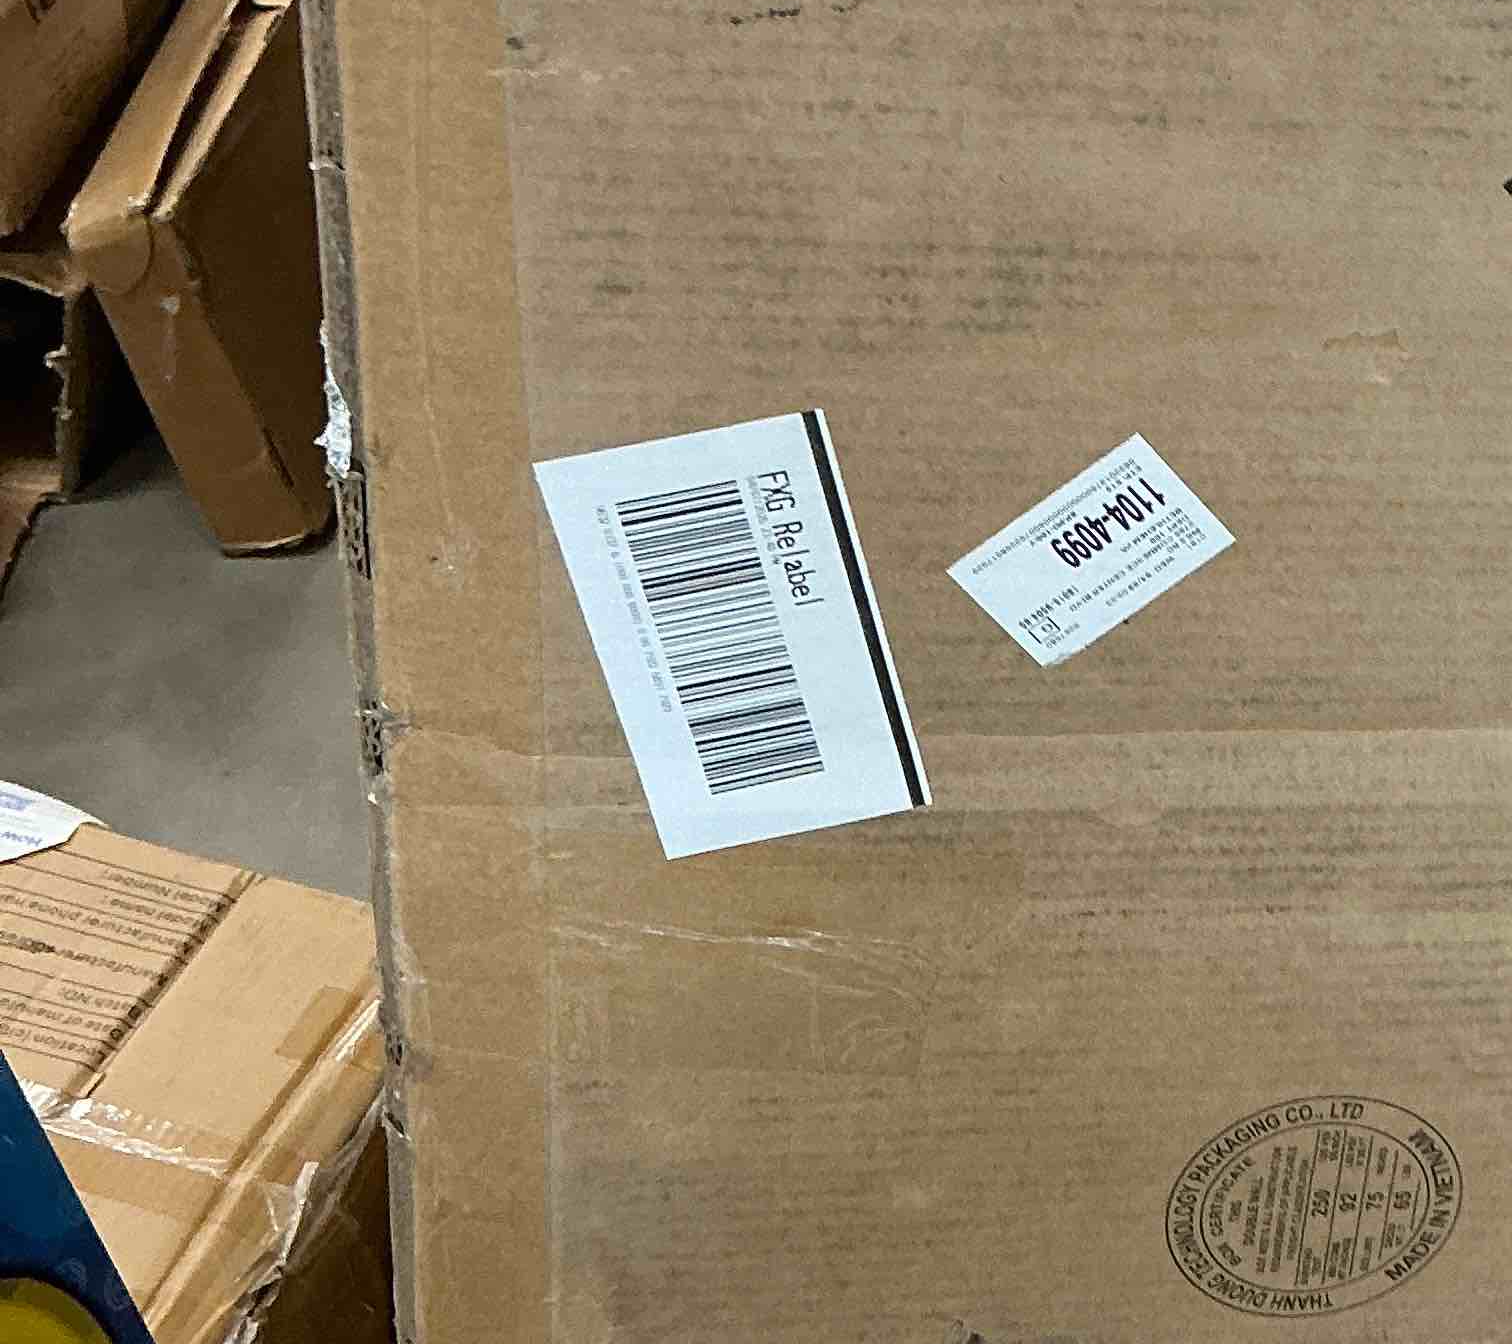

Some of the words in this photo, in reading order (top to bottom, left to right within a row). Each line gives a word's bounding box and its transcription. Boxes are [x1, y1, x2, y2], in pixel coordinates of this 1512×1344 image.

[758, 470, 797, 513] FXG
[1050, 477, 1168, 568] 1104-4099
[774, 520, 825, 607] Relabel
[1329, 1101, 1365, 1120] LTD
[1187, 1113, 1280, 1184] PACKAGING
[1408, 1128, 1454, 1207] VIETNAM
[1429, 1208, 1450, 1229] IN
[1384, 1232, 1441, 1280] MADE
[1270, 1292, 1333, 1311] THANH
